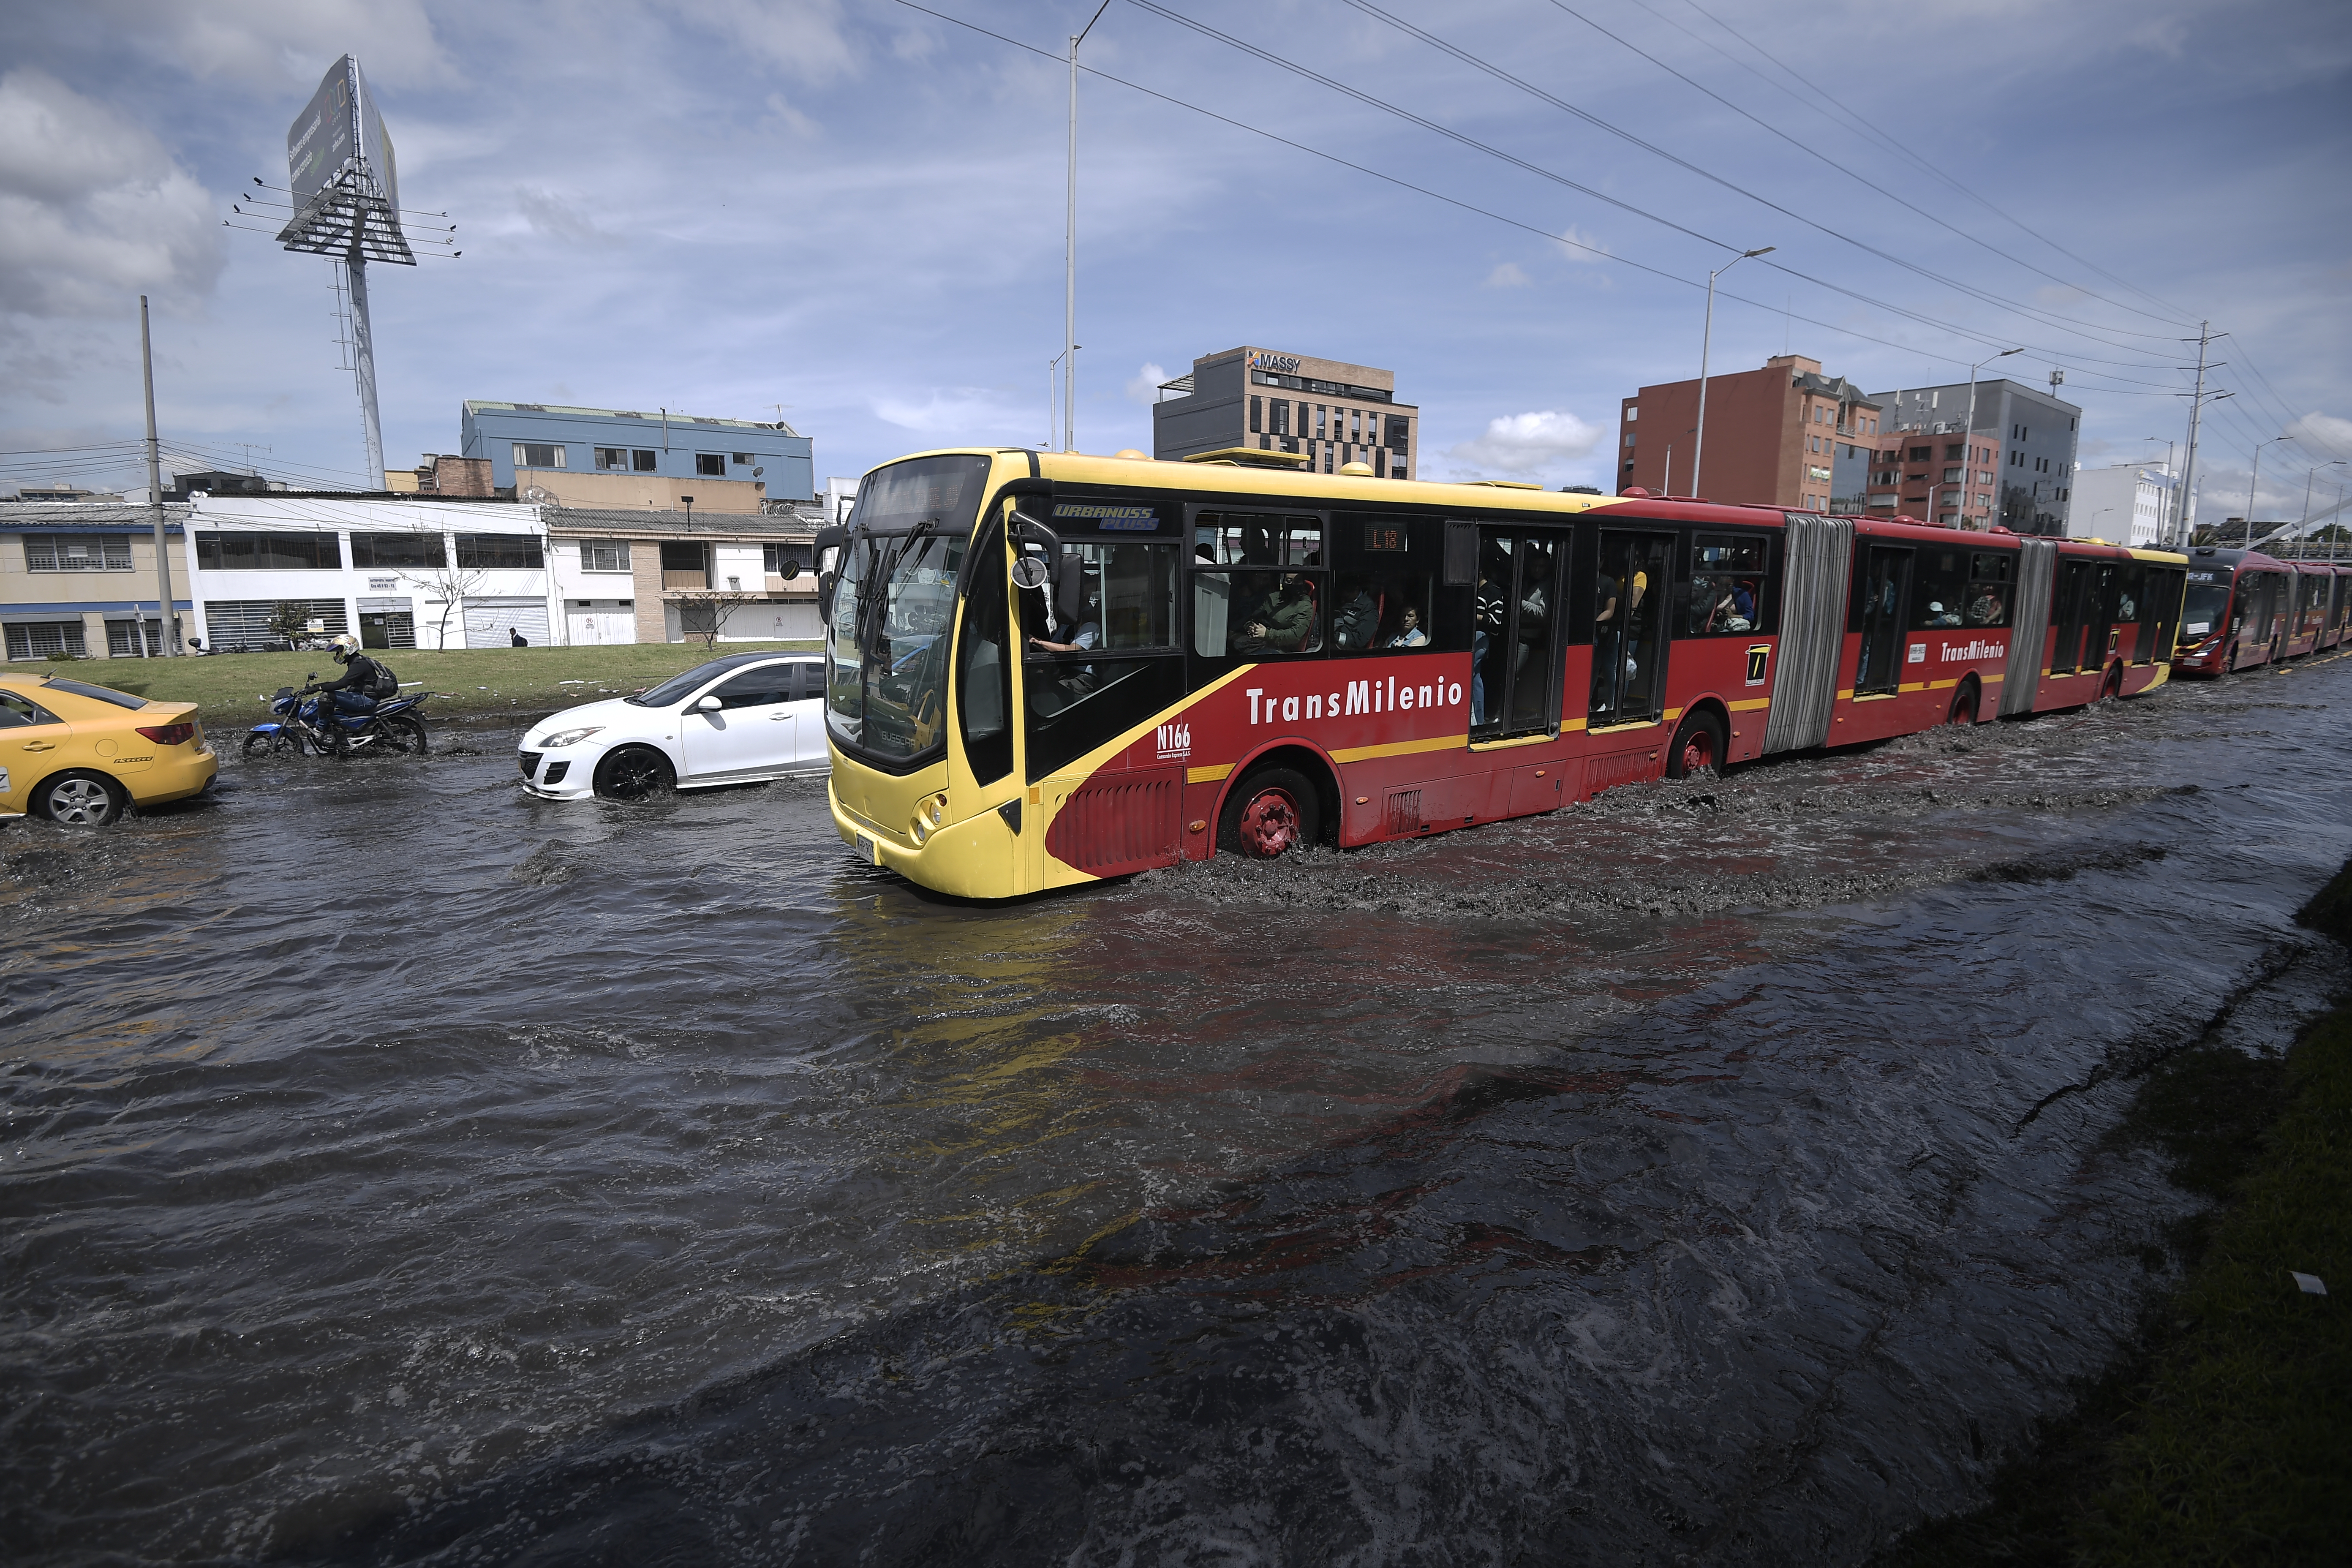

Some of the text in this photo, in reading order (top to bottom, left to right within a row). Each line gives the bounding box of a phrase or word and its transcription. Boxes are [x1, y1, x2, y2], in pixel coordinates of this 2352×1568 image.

[1259, 353, 1301, 372] MASSY
[1055, 506, 1153, 519] URBANUSS
[1102, 519, 1158, 529] PLUSS
[1941, 639, 2004, 662] TransMilenio
[1246, 675, 1462, 725] TransMilenio
[882, 731, 916, 749] BUSSCAR
[1157, 723, 1190, 750] N166
